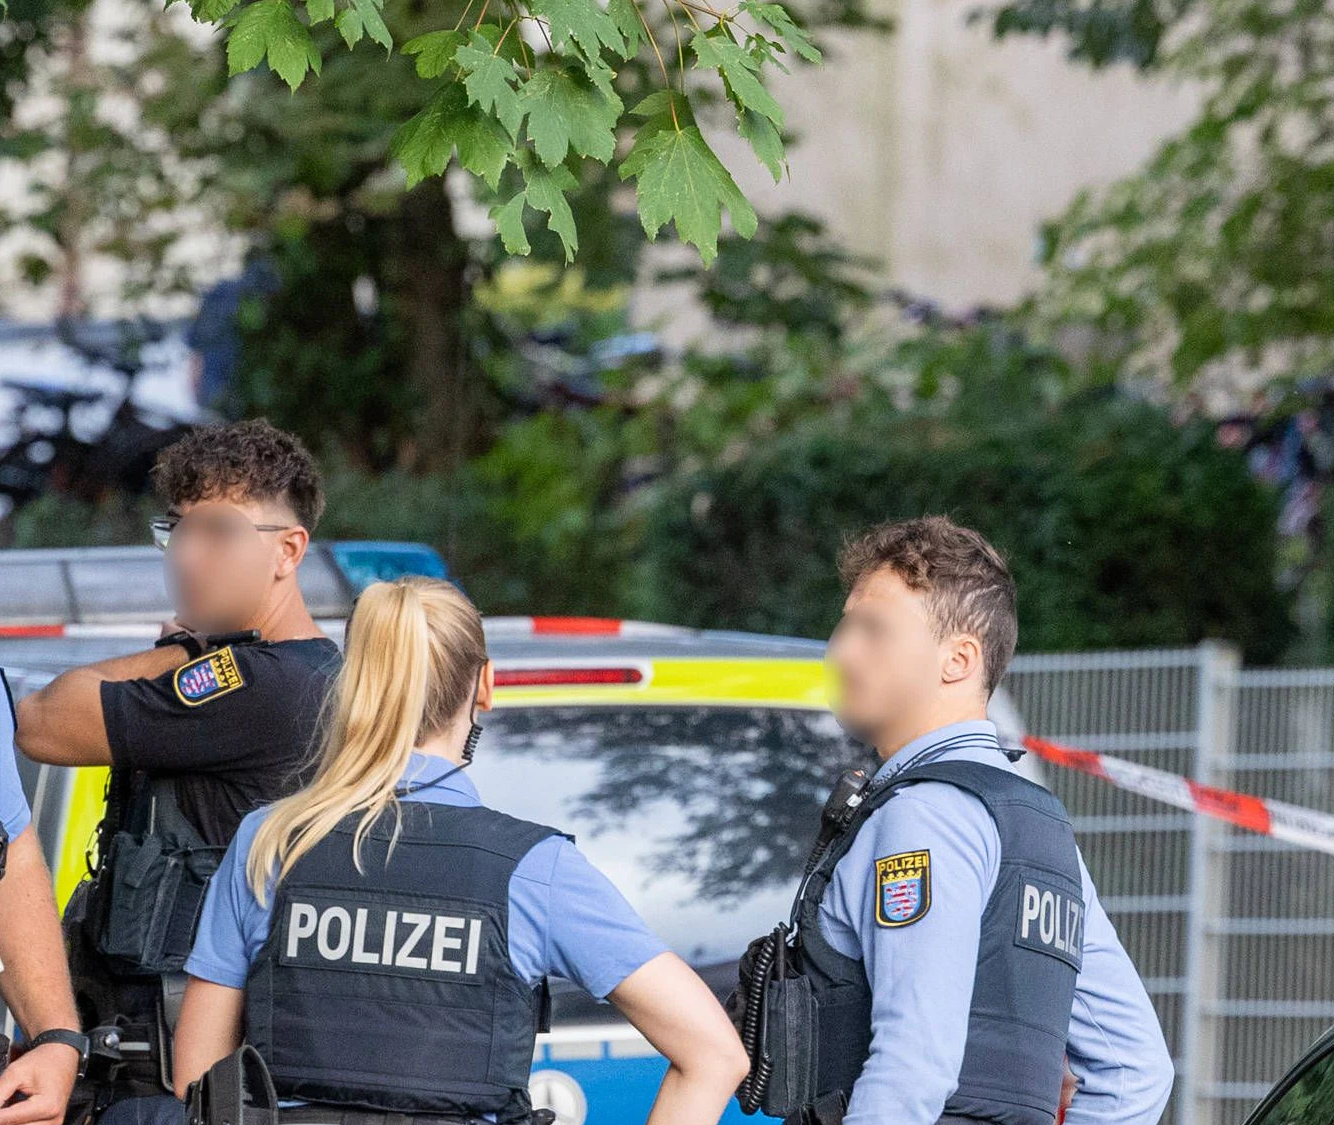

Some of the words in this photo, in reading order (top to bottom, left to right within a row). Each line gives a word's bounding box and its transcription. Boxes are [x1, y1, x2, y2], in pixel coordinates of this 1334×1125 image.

[218, 648, 240, 688] POLIZEI
[879, 855, 927, 872] POLIZEI
[286, 902, 482, 975] POLIZEI
